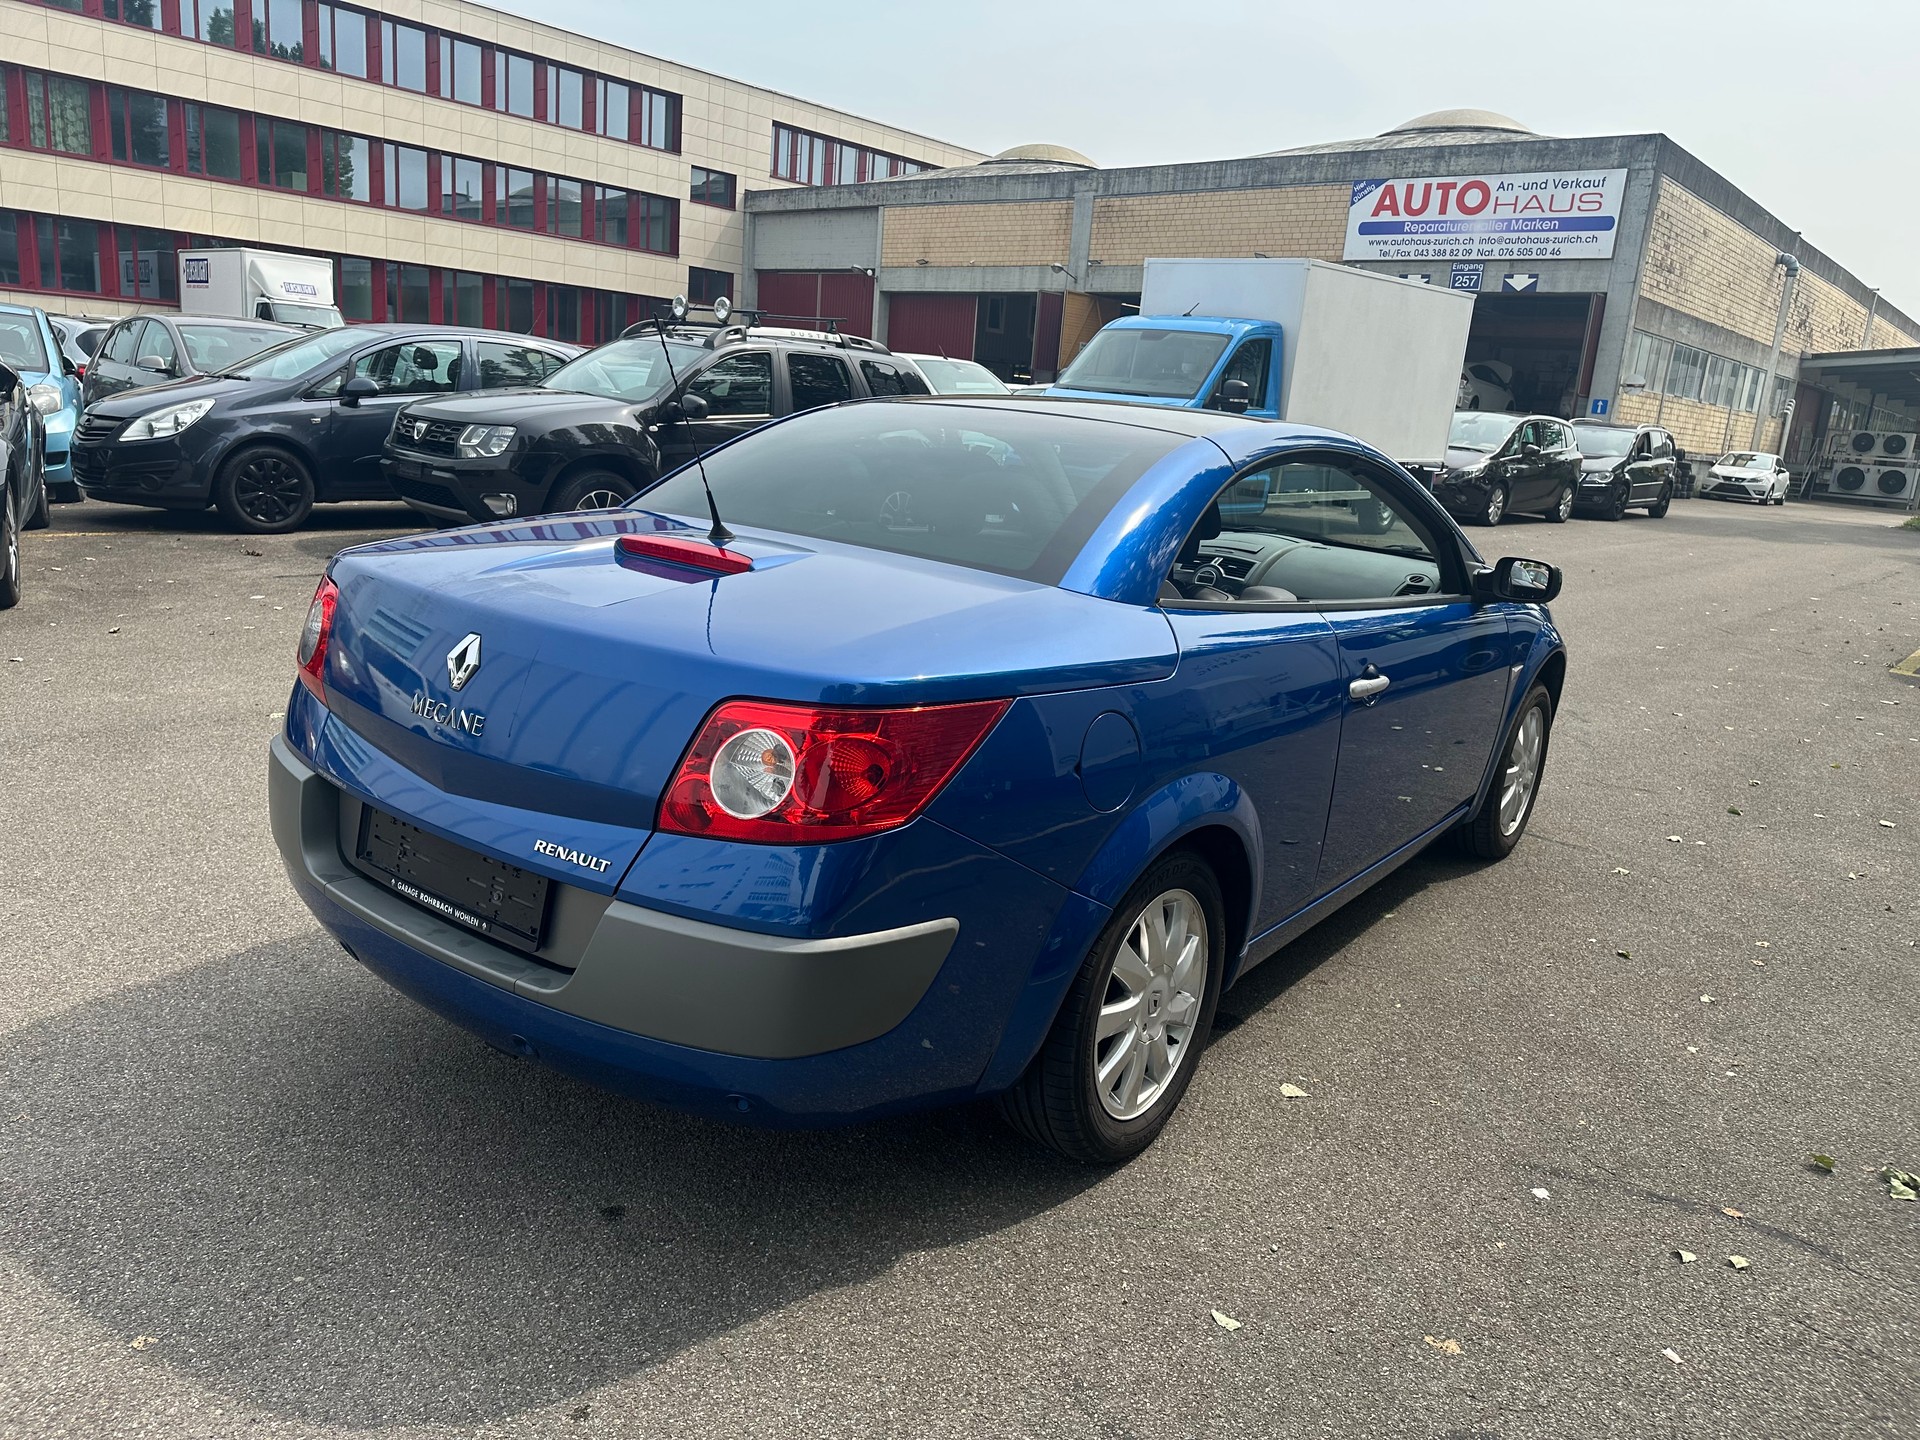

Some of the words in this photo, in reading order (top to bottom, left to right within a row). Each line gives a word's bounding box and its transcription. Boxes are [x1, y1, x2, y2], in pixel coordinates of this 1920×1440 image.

[1353, 181, 1366, 192] Hier
[1496, 181, 1514, 191] An
[1518, 179, 1548, 191] -und
[1553, 177, 1607, 190] Verkauf
[1370, 180, 1491, 217] AUTO
[1493, 192, 1604, 214] HAUS
[1404, 221, 1475, 234] Reparaturen
[1481, 220, 1508, 231] aller
[1511, 219, 1559, 230] Marken
[1368, 236, 1475, 246] www.autohaus-zurich.ch
[1478, 234, 1598, 245] info@autohaus-zurich.ch
[1379, 249, 1412, 258] Tel./Fax
[1414, 248, 1429, 257] 043
[1431, 248, 1447, 257] 388
[1461, 248, 1473, 257] 09
[1477, 248, 1496, 257] Nat.
[1498, 248, 1514, 257] 076
[1516, 247, 1533, 257] 505
[1535, 247, 1548, 257] 00
[1549, 247, 1562, 257] 46
[1452, 262, 1484, 271] Eingang
[1454, 275, 1478, 287] 257
[790, 331, 838, 340] DUSTER
[410, 693, 486, 737] MEGANE
[534, 839, 611, 873] RENAULT
[397, 881, 419, 898] GARAGE
[420, 892, 453, 915] ROHRBACH
[454, 909, 480, 927] WOHLEN
